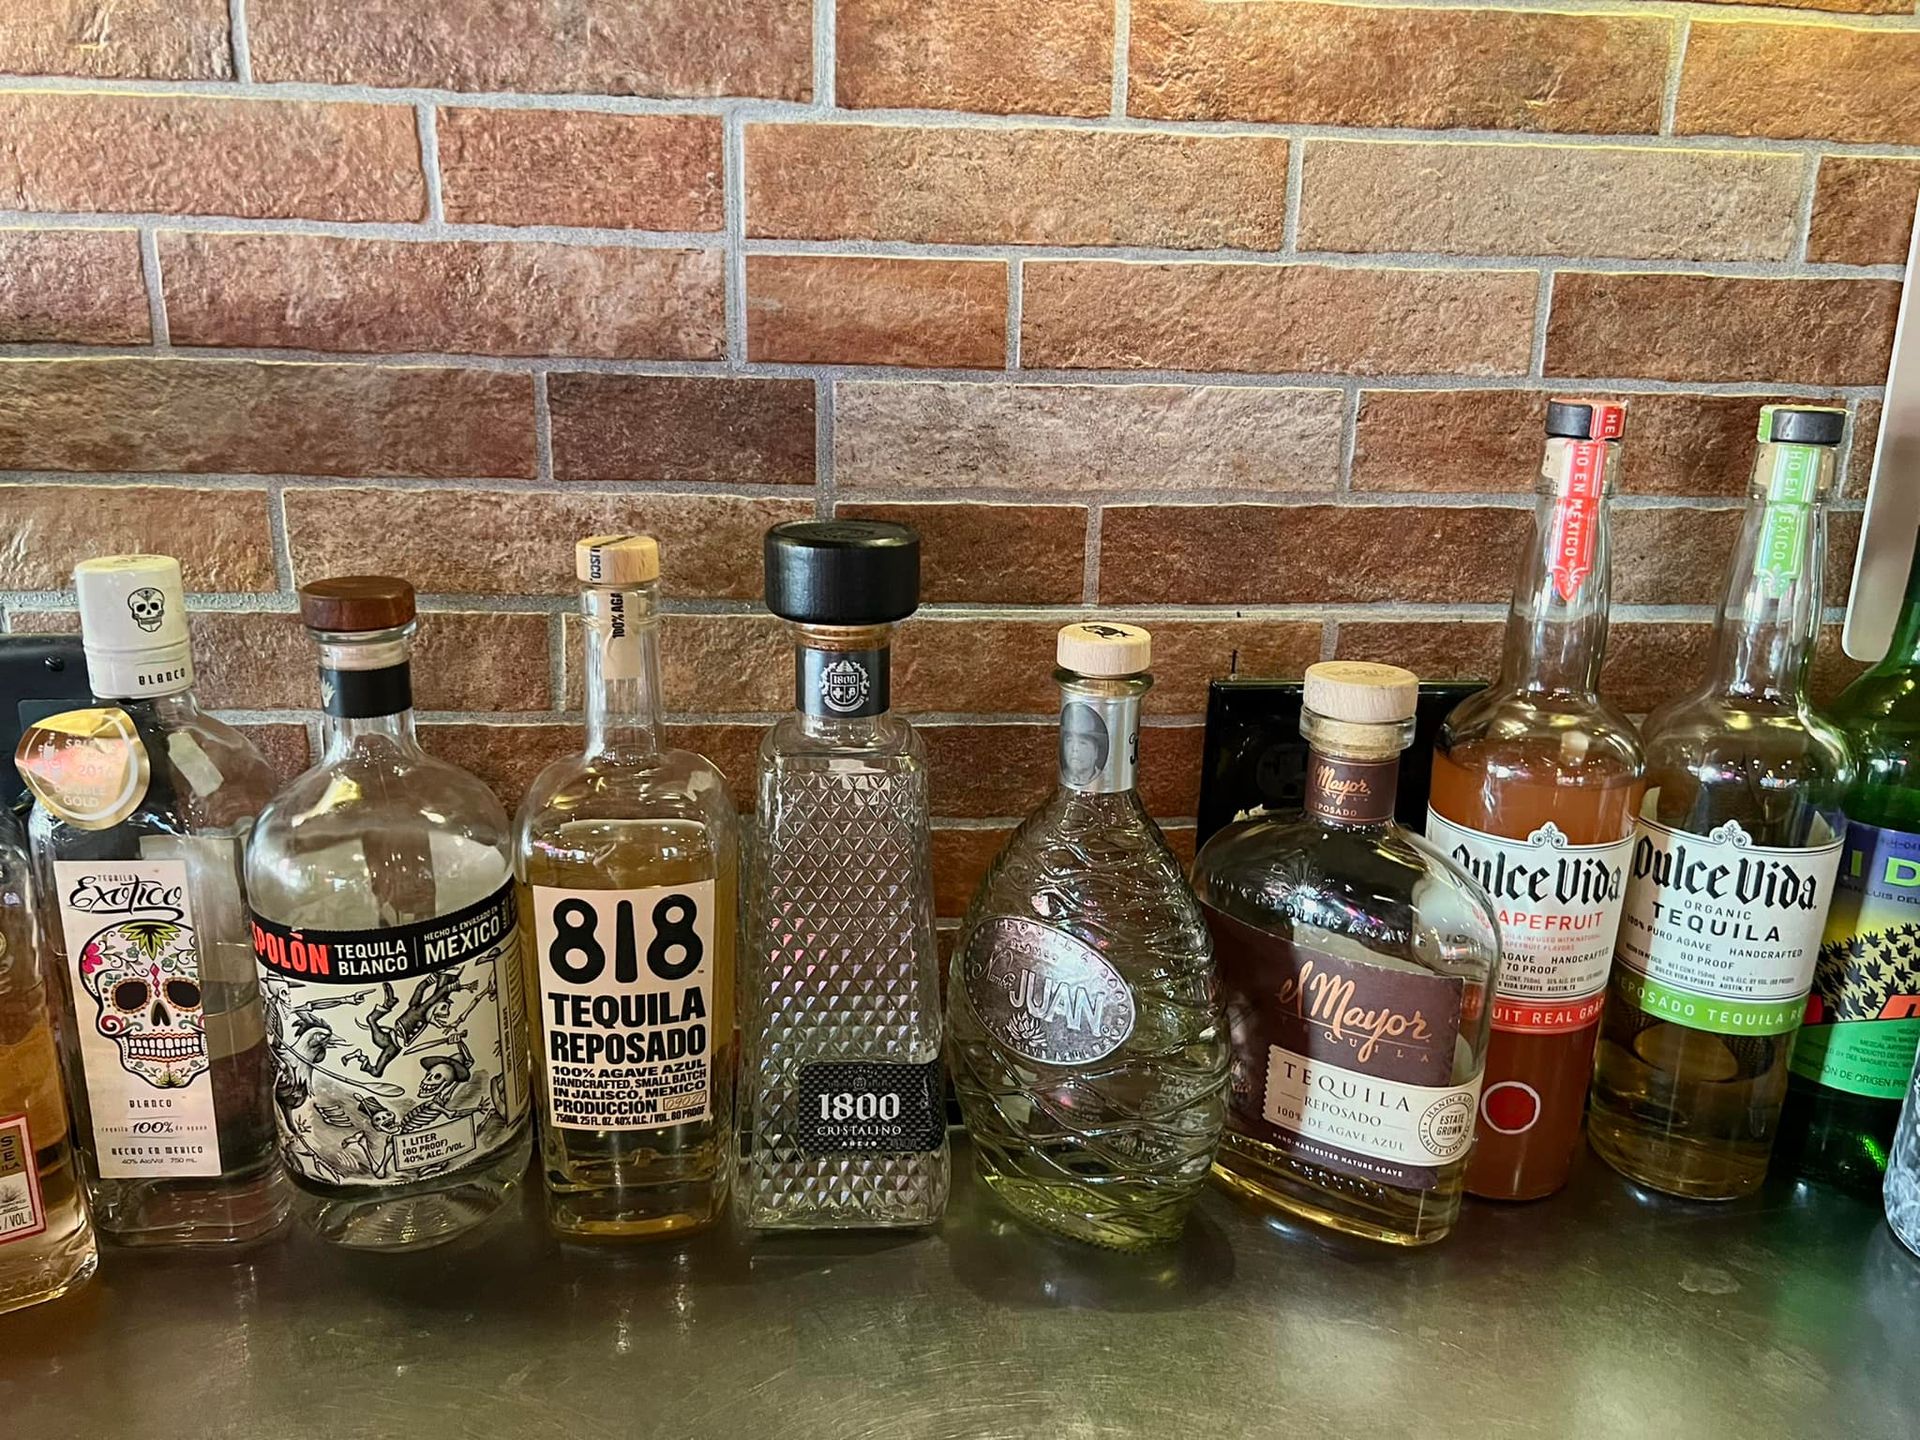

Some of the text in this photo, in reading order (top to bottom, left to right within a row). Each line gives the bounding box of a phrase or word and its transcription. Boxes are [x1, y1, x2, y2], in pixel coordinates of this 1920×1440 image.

[1572, 473, 1587, 494] EN
[1784, 478, 1799, 498] EN
[612, 614, 625, 639] 100%
[138, 668, 187, 686] BLANCO
[833, 674, 857, 685] 1800
[1317, 766, 1368, 806] Mayor
[64, 796, 99, 808] GOLD
[97, 874, 133, 882] TEQUILA
[1555, 857, 1621, 905] Vida
[1634, 836, 1730, 900] Dulce
[1735, 858, 1816, 911] Vida
[68, 874, 183, 917] Exotico
[1684, 900, 1752, 921] ORGANIC
[1499, 910, 1604, 931] APEFRUIT
[1652, 902, 1780, 942] TEQUILA
[424, 928, 450, 942] HECHO
[452, 925, 458, 933] &
[424, 916, 500, 965] MEXICO
[549, 894, 704, 984] 818
[1647, 926, 1672, 942] PURO
[1676, 936, 1712, 952] AGAVE
[1730, 948, 1802, 960] HANDCRAFTED
[334, 940, 406, 959] TEQUILA
[1500, 952, 1536, 964] AGAVE
[1552, 946, 1609, 964] HANDCRAFTED
[1504, 941, 1541, 950] APEFRUIT
[338, 956, 408, 976] BLANCO
[1506, 962, 1558, 974] 70 PROOF
[1680, 952, 1735, 970] 80 PROOF
[1504, 982, 1518, 990] VIDA
[1520, 984, 1542, 992] SPIRITS
[1690, 976, 1714, 987] SPIRITS
[548, 986, 706, 1030] TEQUILA
[1009, 968, 1106, 1038] JUAN
[1276, 960, 1433, 1063] el Mayor
[1532, 1008, 1574, 1024] REAL
[1708, 1010, 1784, 1026] TEQUILA
[550, 1024, 706, 1065] REPOSADO
[552, 1060, 706, 1078] 100% AGAVE AZUL
[1840, 1070, 1852, 1080] DE
[1854, 1073, 1891, 1087] ORIGEN
[553, 1068, 706, 1090] HANDCRAFTED, SMALL BATCH
[1283, 1061, 1410, 1112] TEQUILA
[554, 1087, 569, 1098] IN
[645, 1080, 706, 1098] MEXICO
[129, 1100, 172, 1108] BLANCO
[818, 1092, 900, 1121] 1800
[1304, 1096, 1382, 1128] REPOSADO
[580, 1115, 590, 1125] 25
[615, 1116, 632, 1126] 40%
[682, 1105, 706, 1118] PROOF
[1440, 1113, 1465, 1126] ESTATE
[132, 1121, 174, 1134] 100%
[817, 1126, 902, 1136] CRISTALINO
[1276, 1105, 1406, 1152] 100% DE AGAVE AZUL
[1436, 1125, 1463, 1136] GROWN
[402, 1132, 437, 1147] 1 LITER
[402, 1138, 448, 1156] (80 PROOF)
[404, 1154, 424, 1164] 40%
[426, 1150, 444, 1160] ALC.
[1272, 1132, 1403, 1178] HAND-HARVESTED MATURE AGAVE
